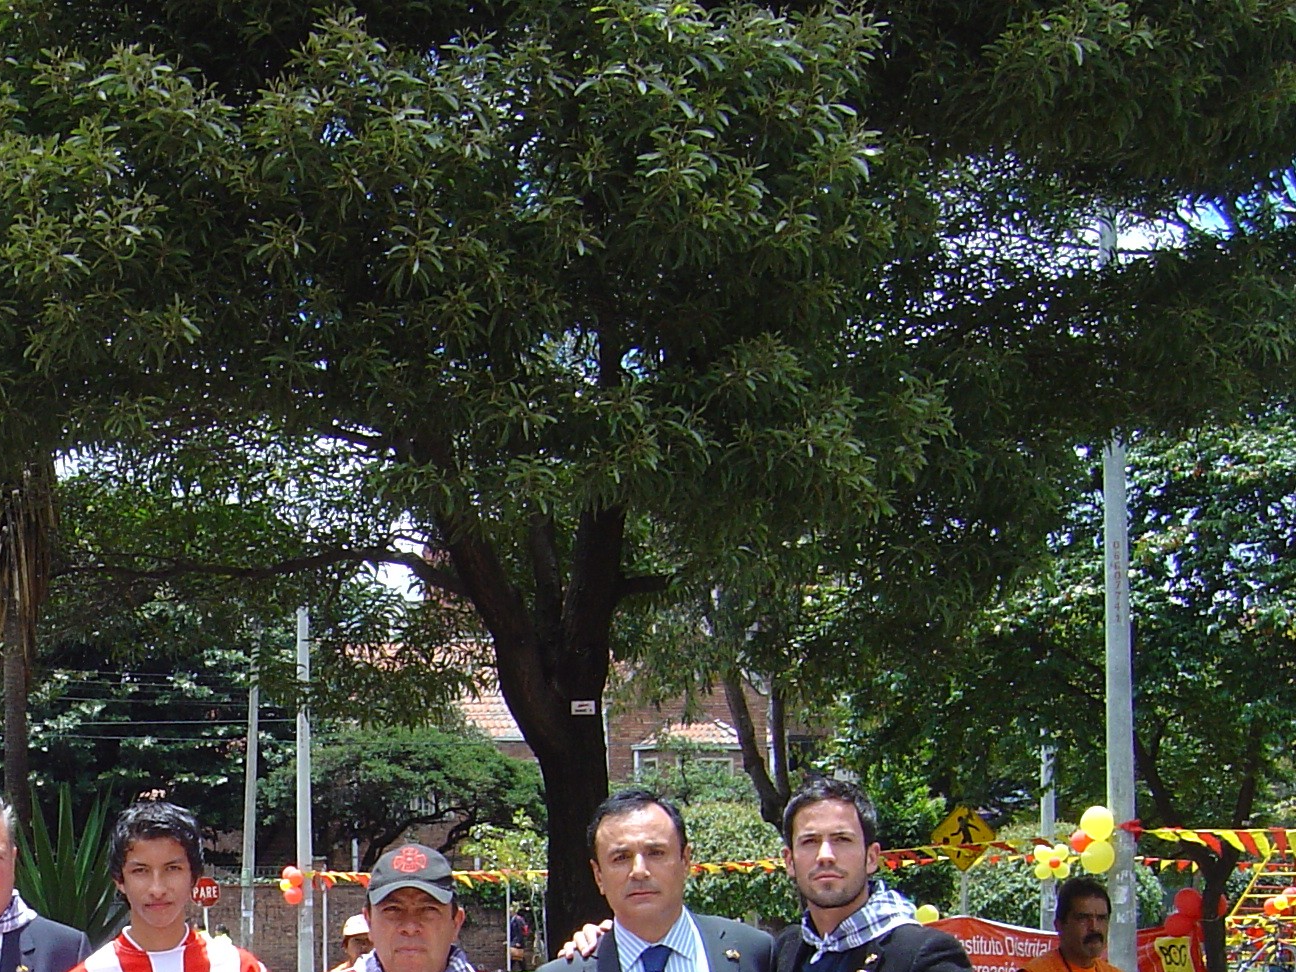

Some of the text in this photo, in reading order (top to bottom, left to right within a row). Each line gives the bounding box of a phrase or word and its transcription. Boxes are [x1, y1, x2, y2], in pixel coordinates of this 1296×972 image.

[192, 886, 218, 899] PARE
[954, 934, 1053, 958] stituto Distrital
